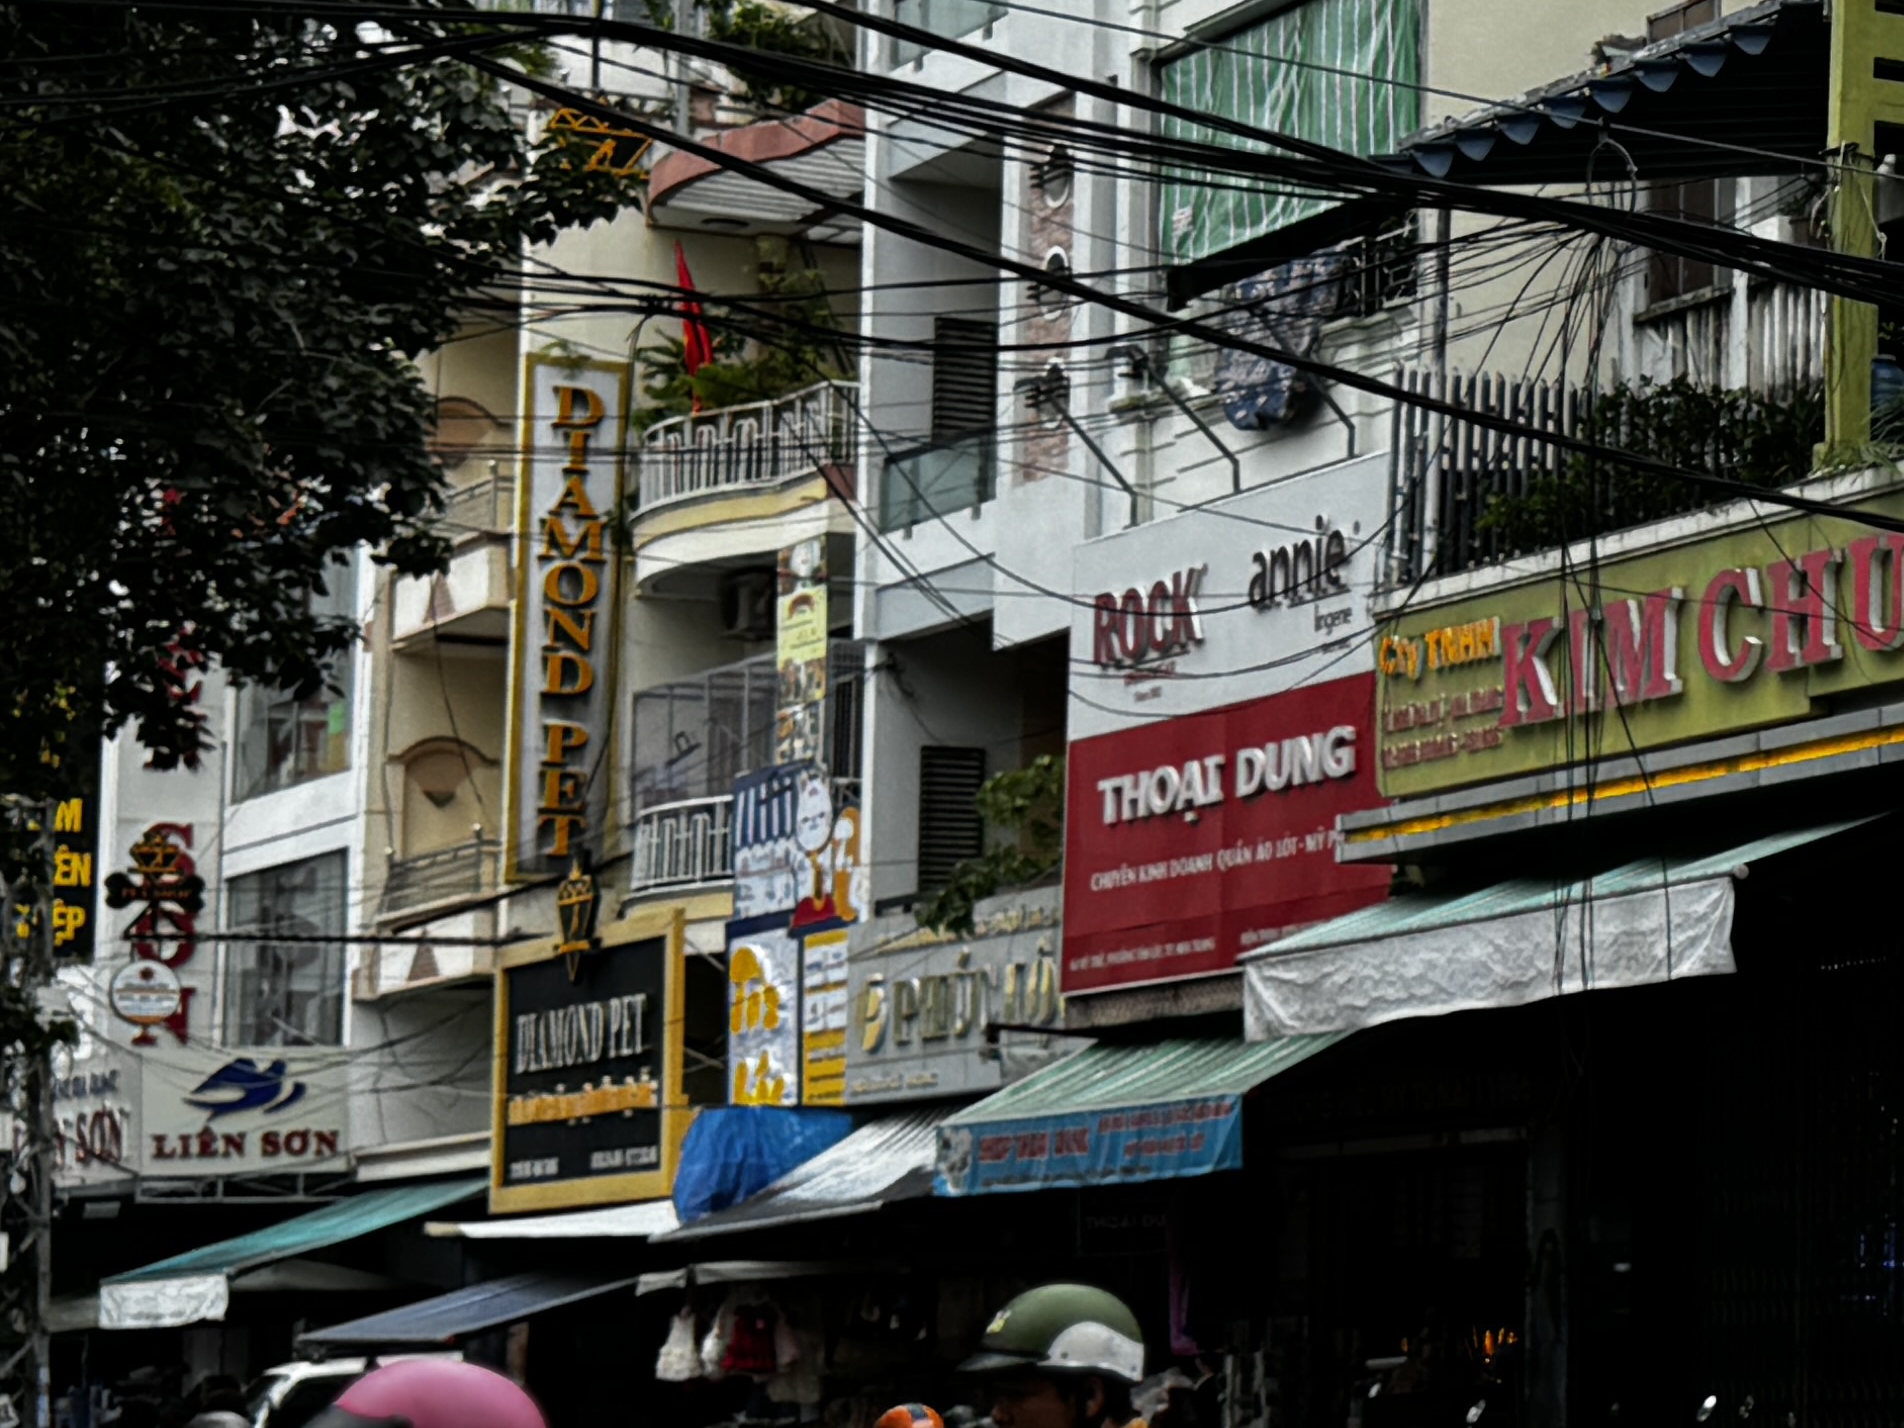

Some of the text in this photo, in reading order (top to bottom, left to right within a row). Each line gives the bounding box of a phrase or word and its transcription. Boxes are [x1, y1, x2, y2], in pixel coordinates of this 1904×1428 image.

[1248, 514, 1352, 613] annie
[537, 386, 607, 857] DIAMOND PET
[1094, 565, 1206, 665] ROCK
[1502, 585, 1685, 728] KIM
[1097, 754, 1225, 825] THOẠI
[1235, 724, 1356, 799] DUNG
[515, 999, 604, 1076] DIAMOND
[608, 992, 648, 1060] PET
[152, 1125, 341, 1161] LIÊN SƠN
